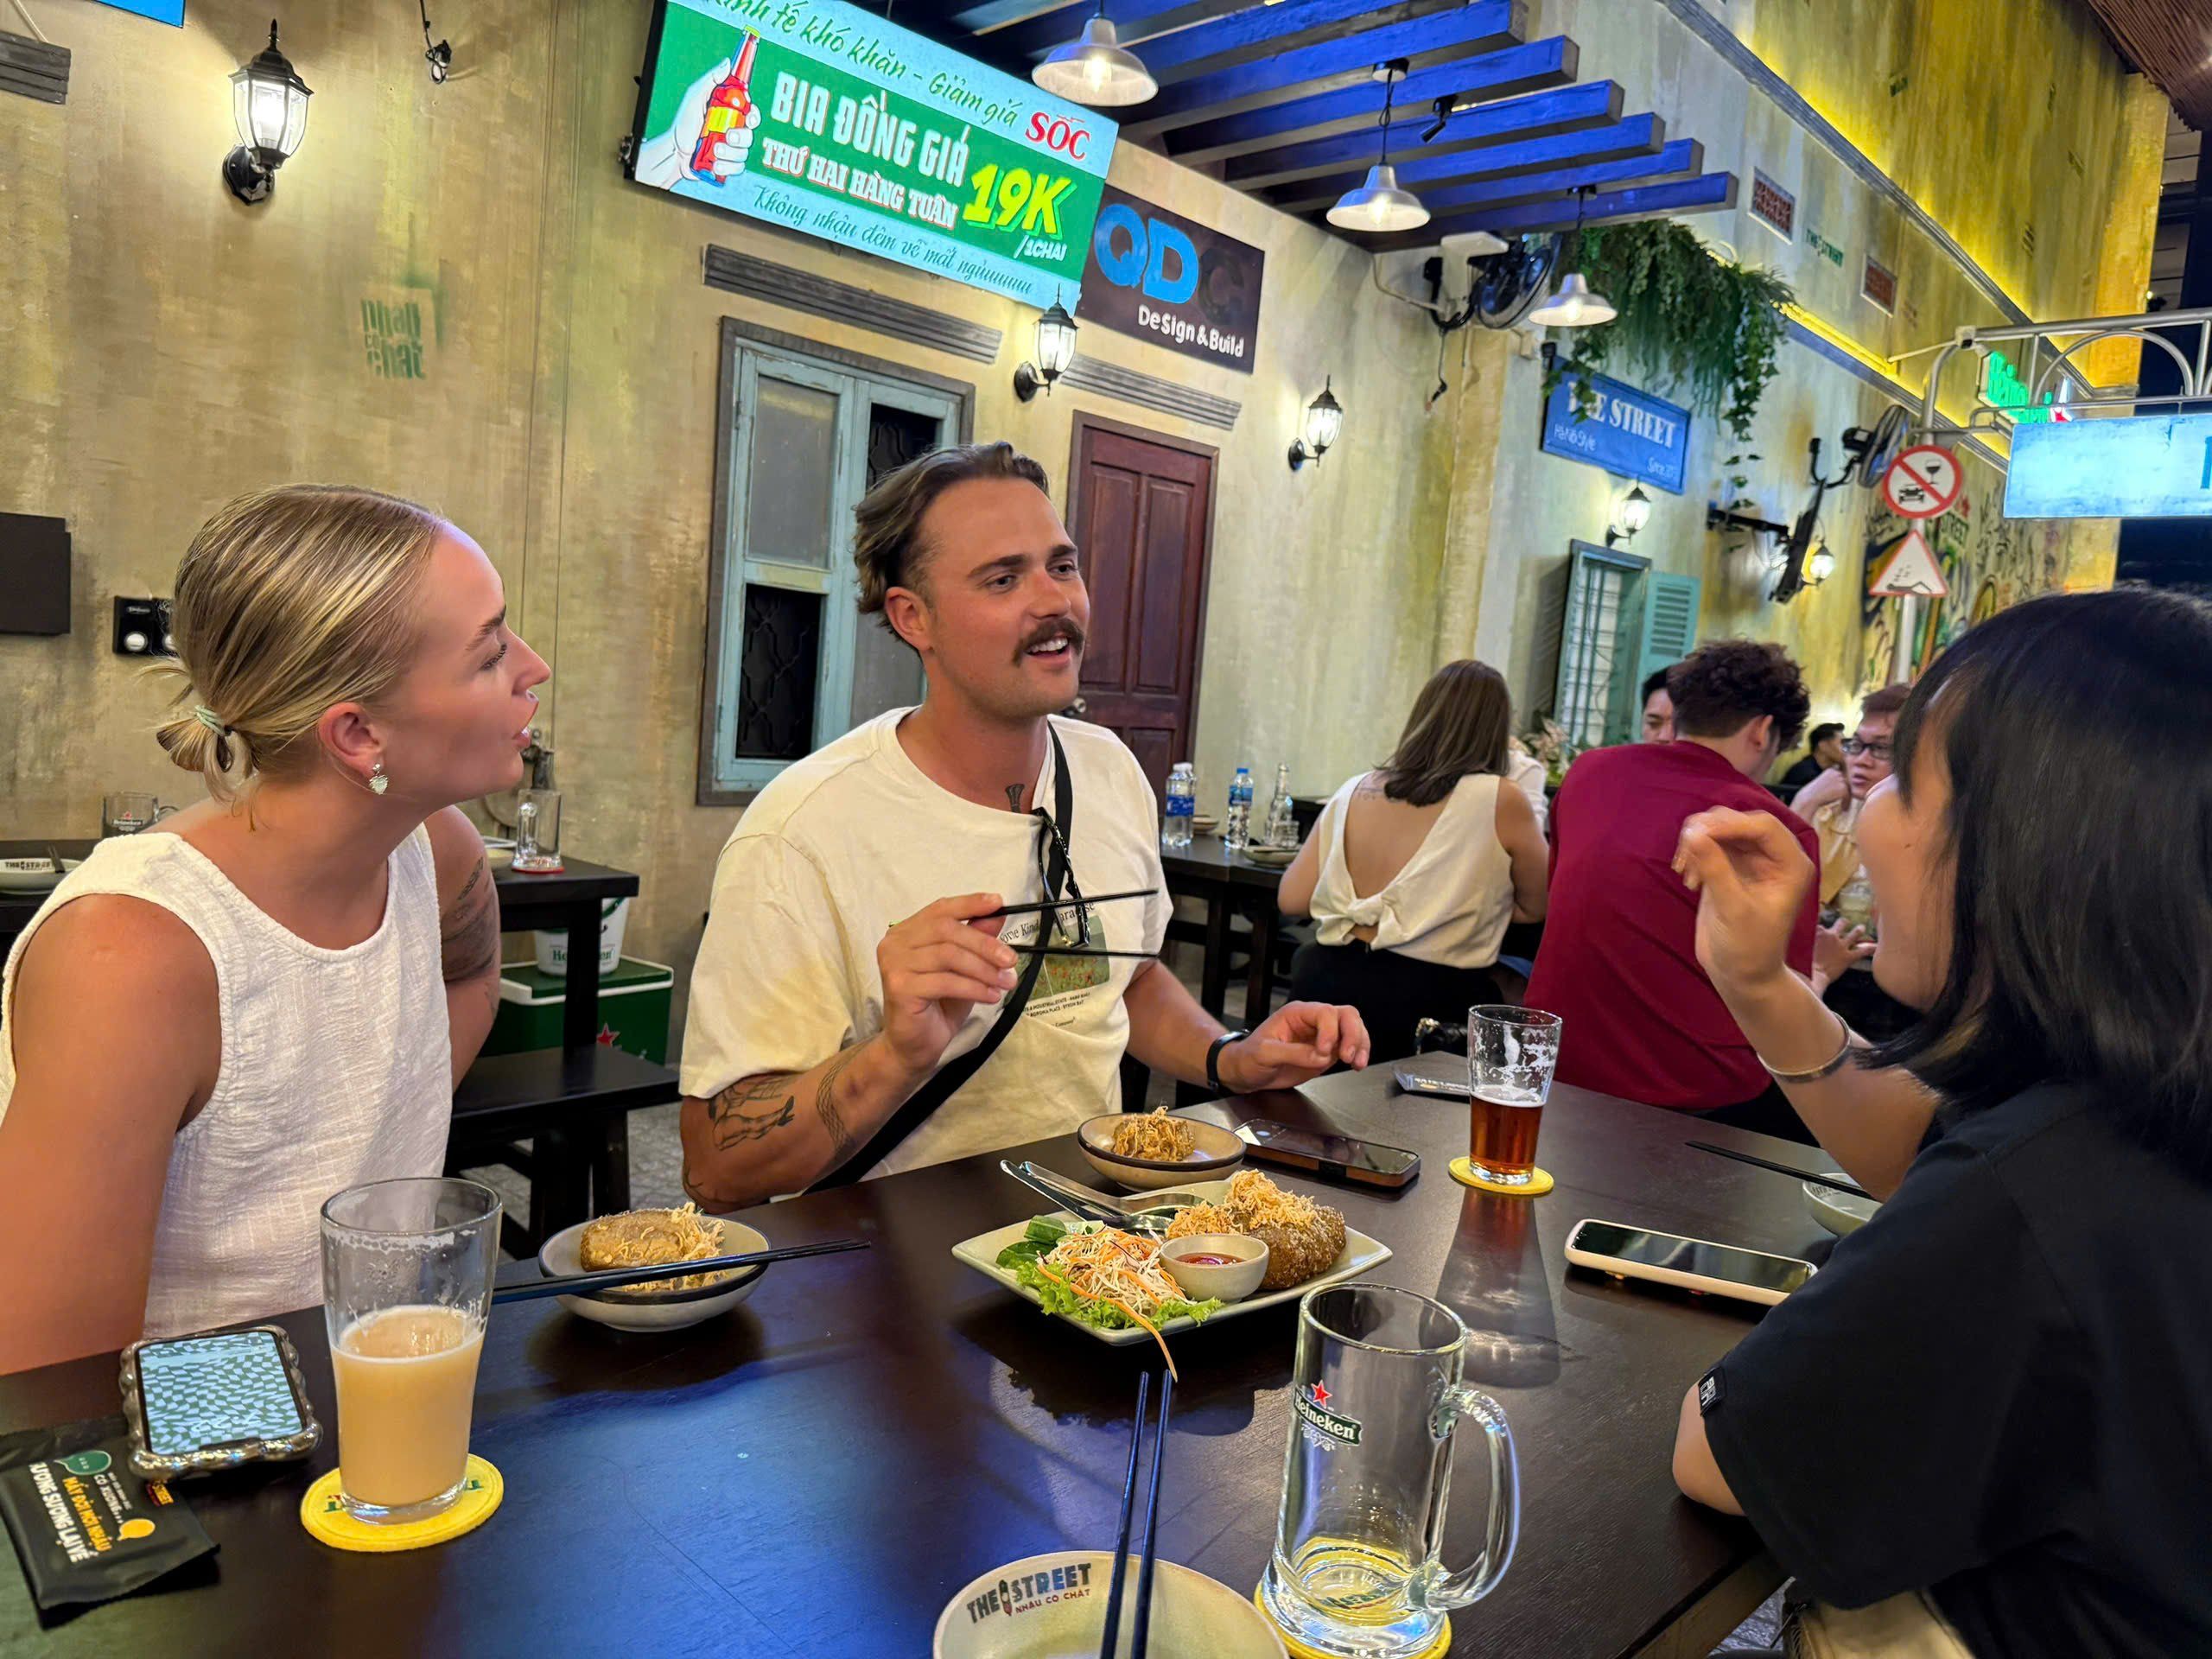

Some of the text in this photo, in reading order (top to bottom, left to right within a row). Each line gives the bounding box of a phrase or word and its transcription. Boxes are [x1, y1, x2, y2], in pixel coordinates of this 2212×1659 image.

[772, 0, 809, 34] tế
[800, 16, 850, 53] khó
[847, 36, 907, 79] khăn
[929, 72, 982, 112] Giảm
[982, 99, 1023, 128] giá
[1025, 111, 1090, 161] SỐC
[770, 70, 970, 188] BIA ĐỒNG GIÁ
[753, 184, 808, 226] Không
[812, 210, 856, 239] nhậu
[861, 224, 897, 251] đêm
[762, 137, 960, 231] THỨ HAI HÀNG TUẦN
[963, 163, 1076, 237] 19K
[1609, 398, 1676, 448] STREET
[966, 1562, 1091, 1624] THE STREET
